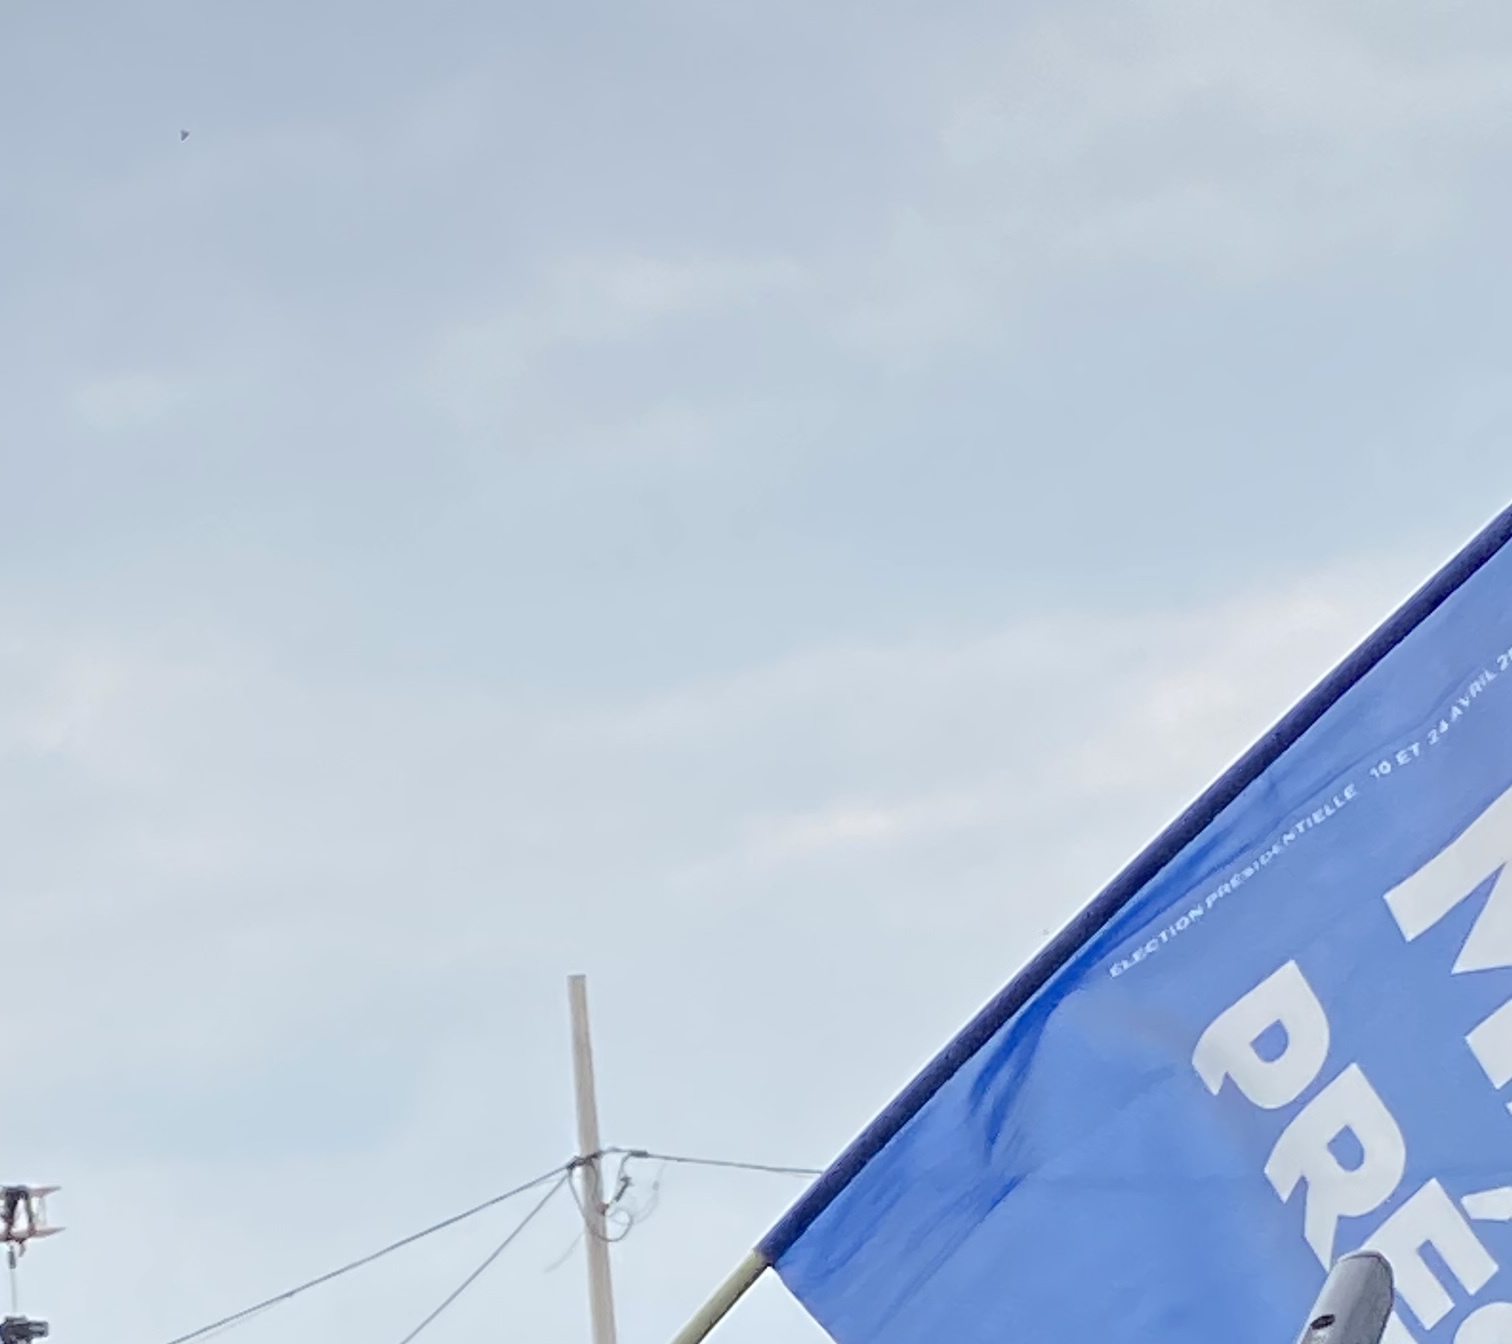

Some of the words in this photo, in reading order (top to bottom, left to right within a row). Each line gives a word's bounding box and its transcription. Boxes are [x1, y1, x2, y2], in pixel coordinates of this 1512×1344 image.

[1108, 903, 1205, 978] ÉLECTION
[1204, 783, 1358, 908] PRÉSIDENTIELLE
[1369, 761, 1391, 779] 10
[1395, 741, 1421, 766] ET
[1450, 669, 1497, 722] AVRIL
